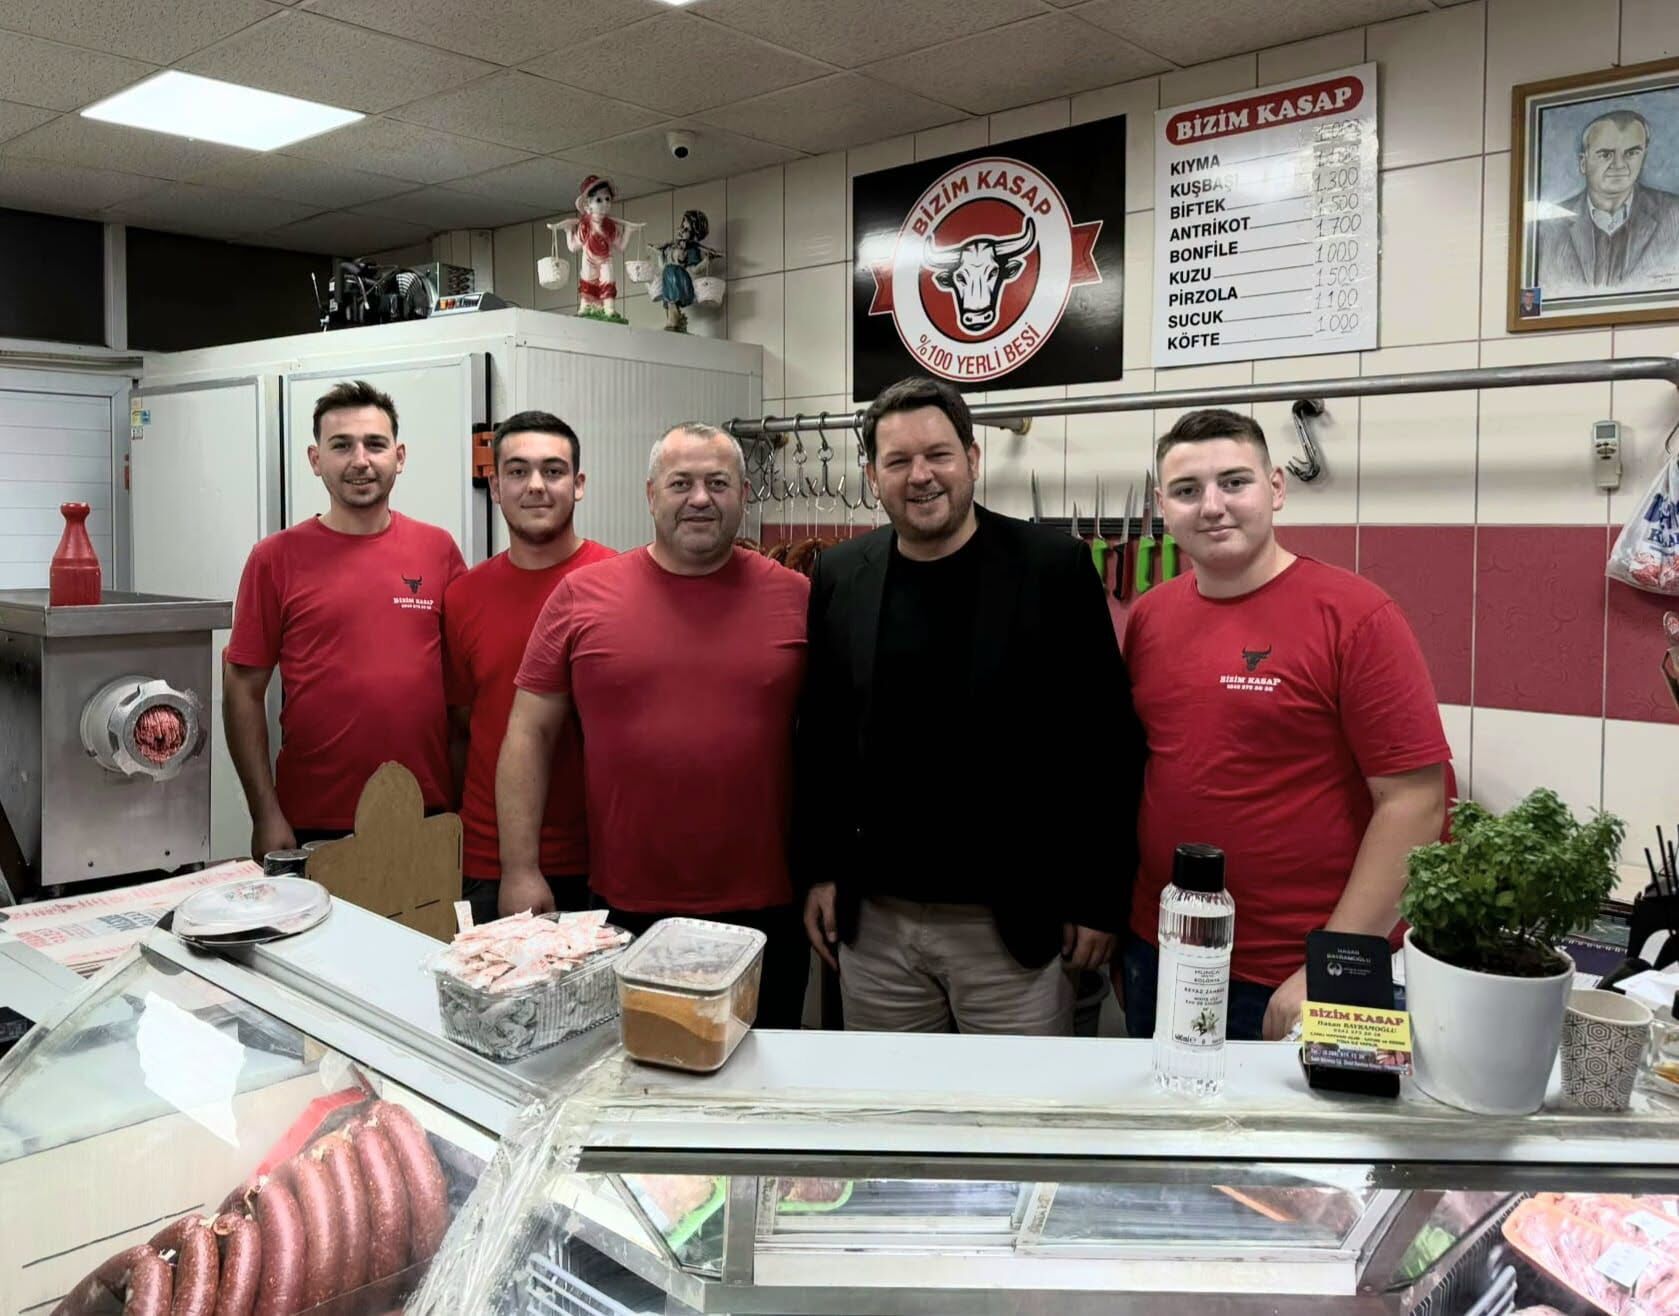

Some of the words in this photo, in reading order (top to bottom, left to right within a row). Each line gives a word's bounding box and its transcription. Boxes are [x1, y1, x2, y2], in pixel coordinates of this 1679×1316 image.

[1176, 109, 1250, 141] BİZİM
[1257, 86, 1353, 125] KASAP
[1170, 154, 1220, 176] KIYMA
[912, 176, 970, 236] BİZİM
[976, 170, 1052, 216] KASAP
[1170, 198, 1226, 219] BİFTEK
[1169, 217, 1251, 241] ANTRİKOT
[1169, 240, 1239, 263] BONFİLE
[1169, 267, 1212, 285] KUZU
[1168, 286, 1238, 307] PİRZOLA
[1168, 310, 1224, 329] SUCUK
[916, 334, 953, 370] %100
[957, 346, 1002, 375] YERLİ
[1003, 322, 1041, 363] BESİ
[1167, 332, 1220, 350] KÖFTE
[1309, 1008, 1350, 1021] BİZİM
[1353, 1012, 1404, 1026] KASAP
